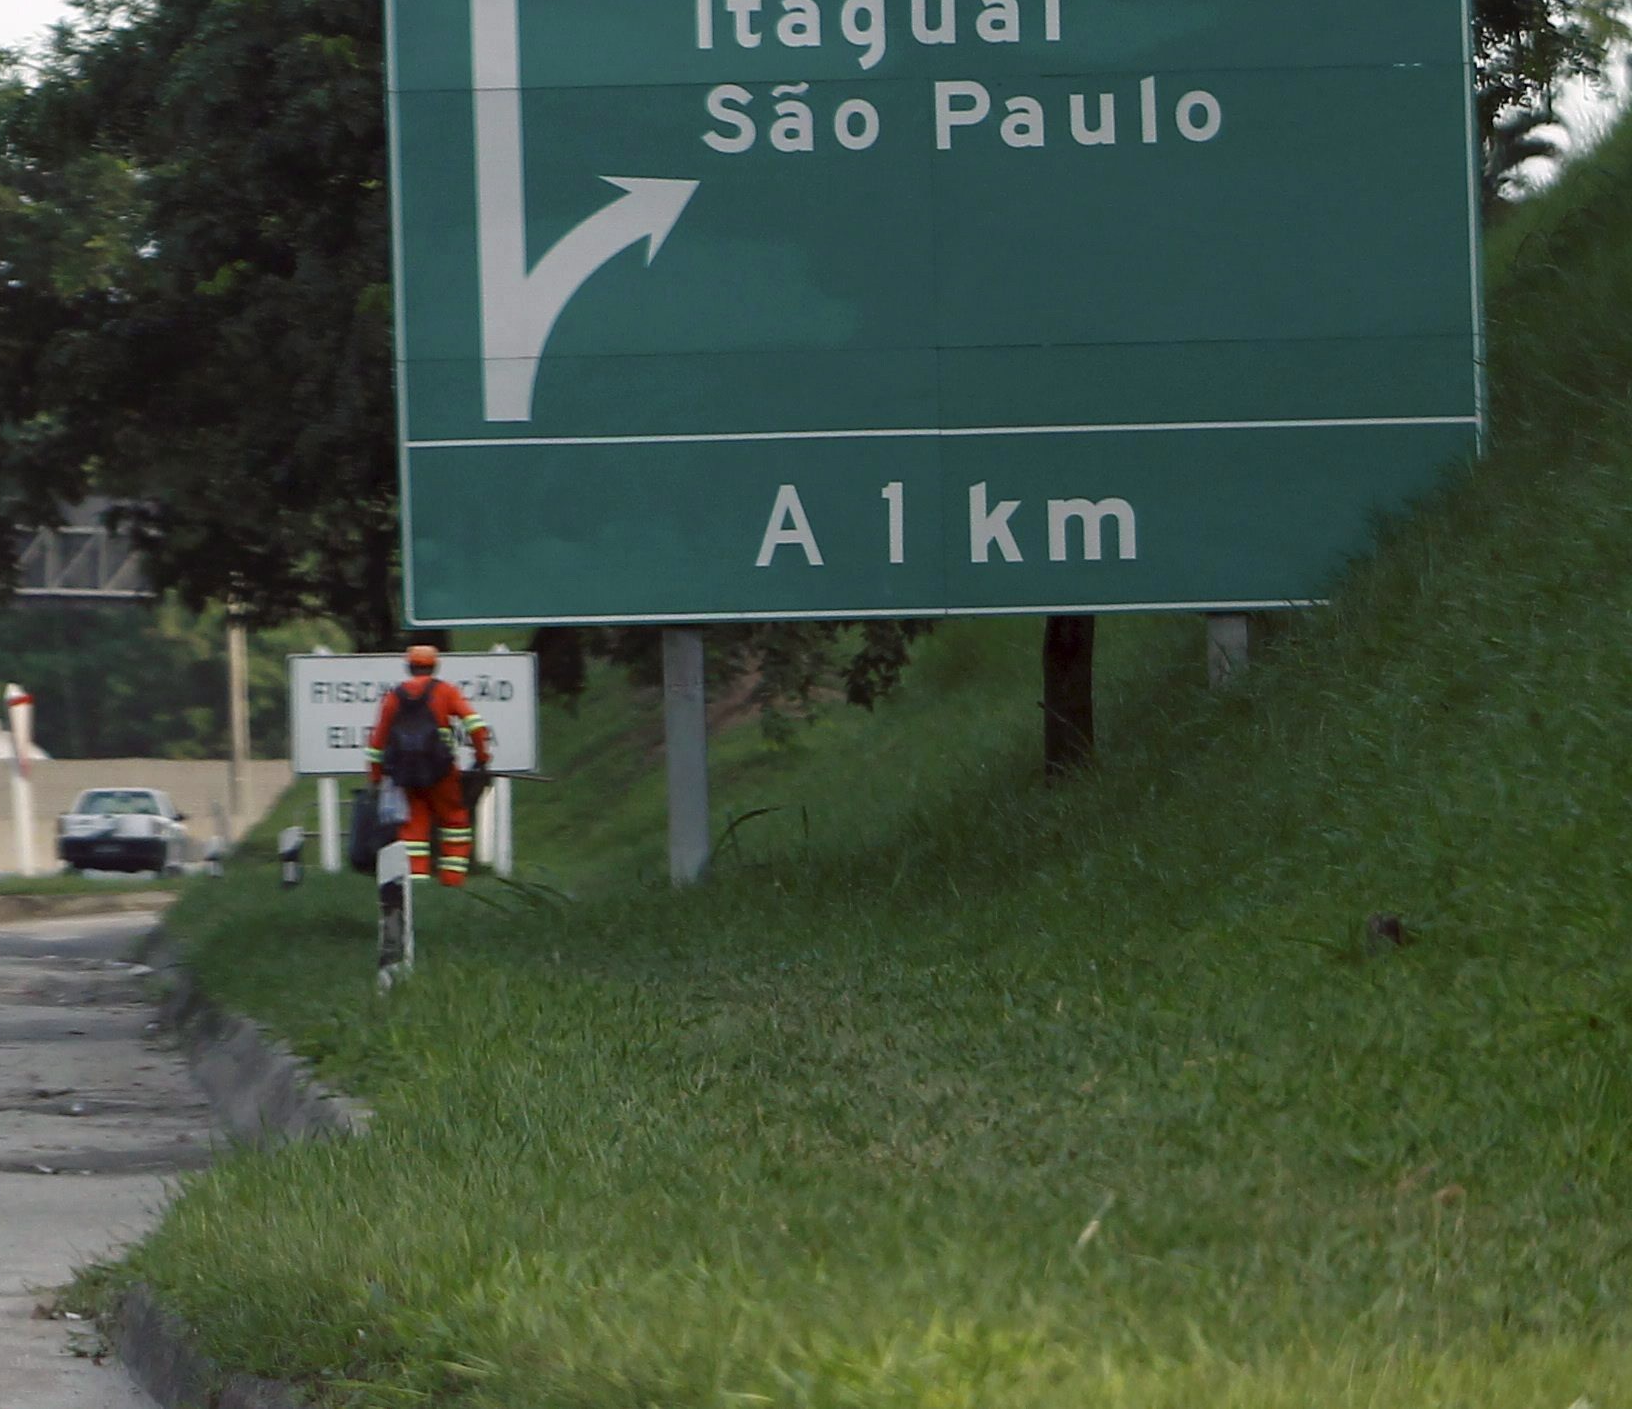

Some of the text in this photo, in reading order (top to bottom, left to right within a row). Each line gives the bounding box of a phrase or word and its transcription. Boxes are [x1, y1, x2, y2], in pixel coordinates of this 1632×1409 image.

[701, 76, 1222, 154] São Paulo
[755, 481, 1138, 567] A 1 km
